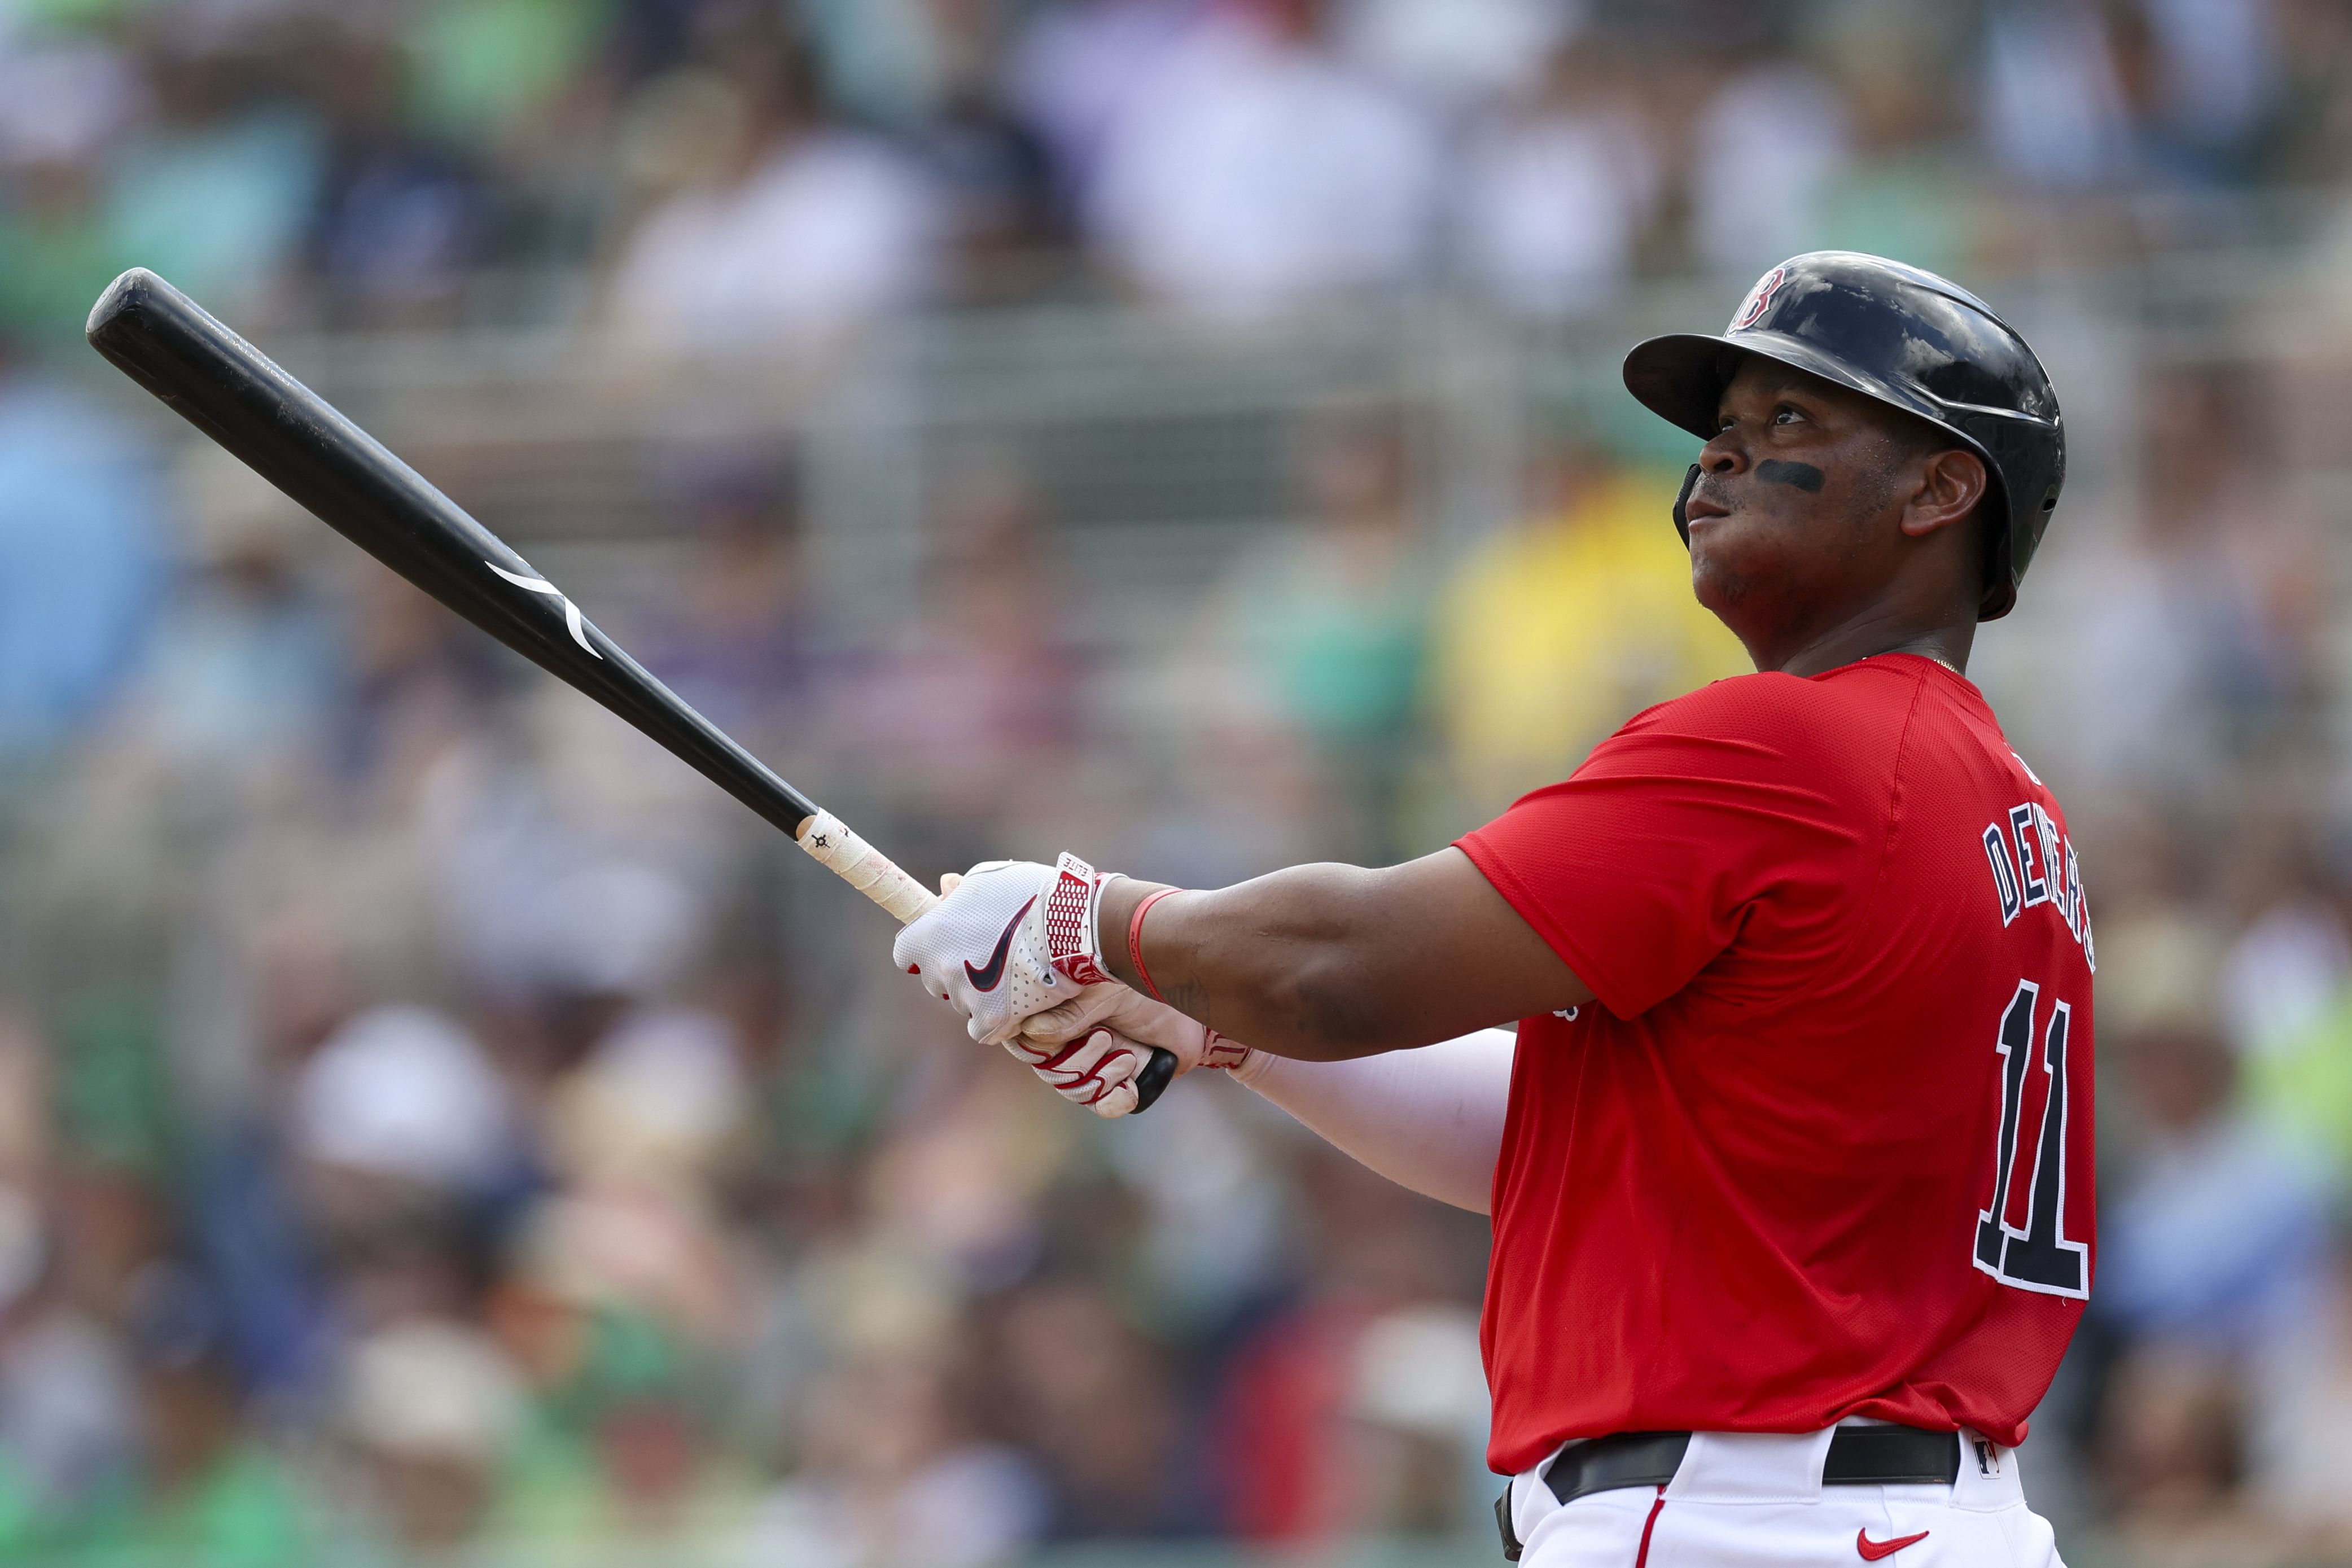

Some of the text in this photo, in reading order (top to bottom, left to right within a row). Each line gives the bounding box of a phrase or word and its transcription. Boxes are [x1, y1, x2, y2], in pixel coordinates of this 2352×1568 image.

[1727, 268, 1787, 335] B
[229, 340, 290, 386] PRO RESERVE
[1063, 857, 1088, 877] ELITE
[1972, 978, 2090, 1300] 11
